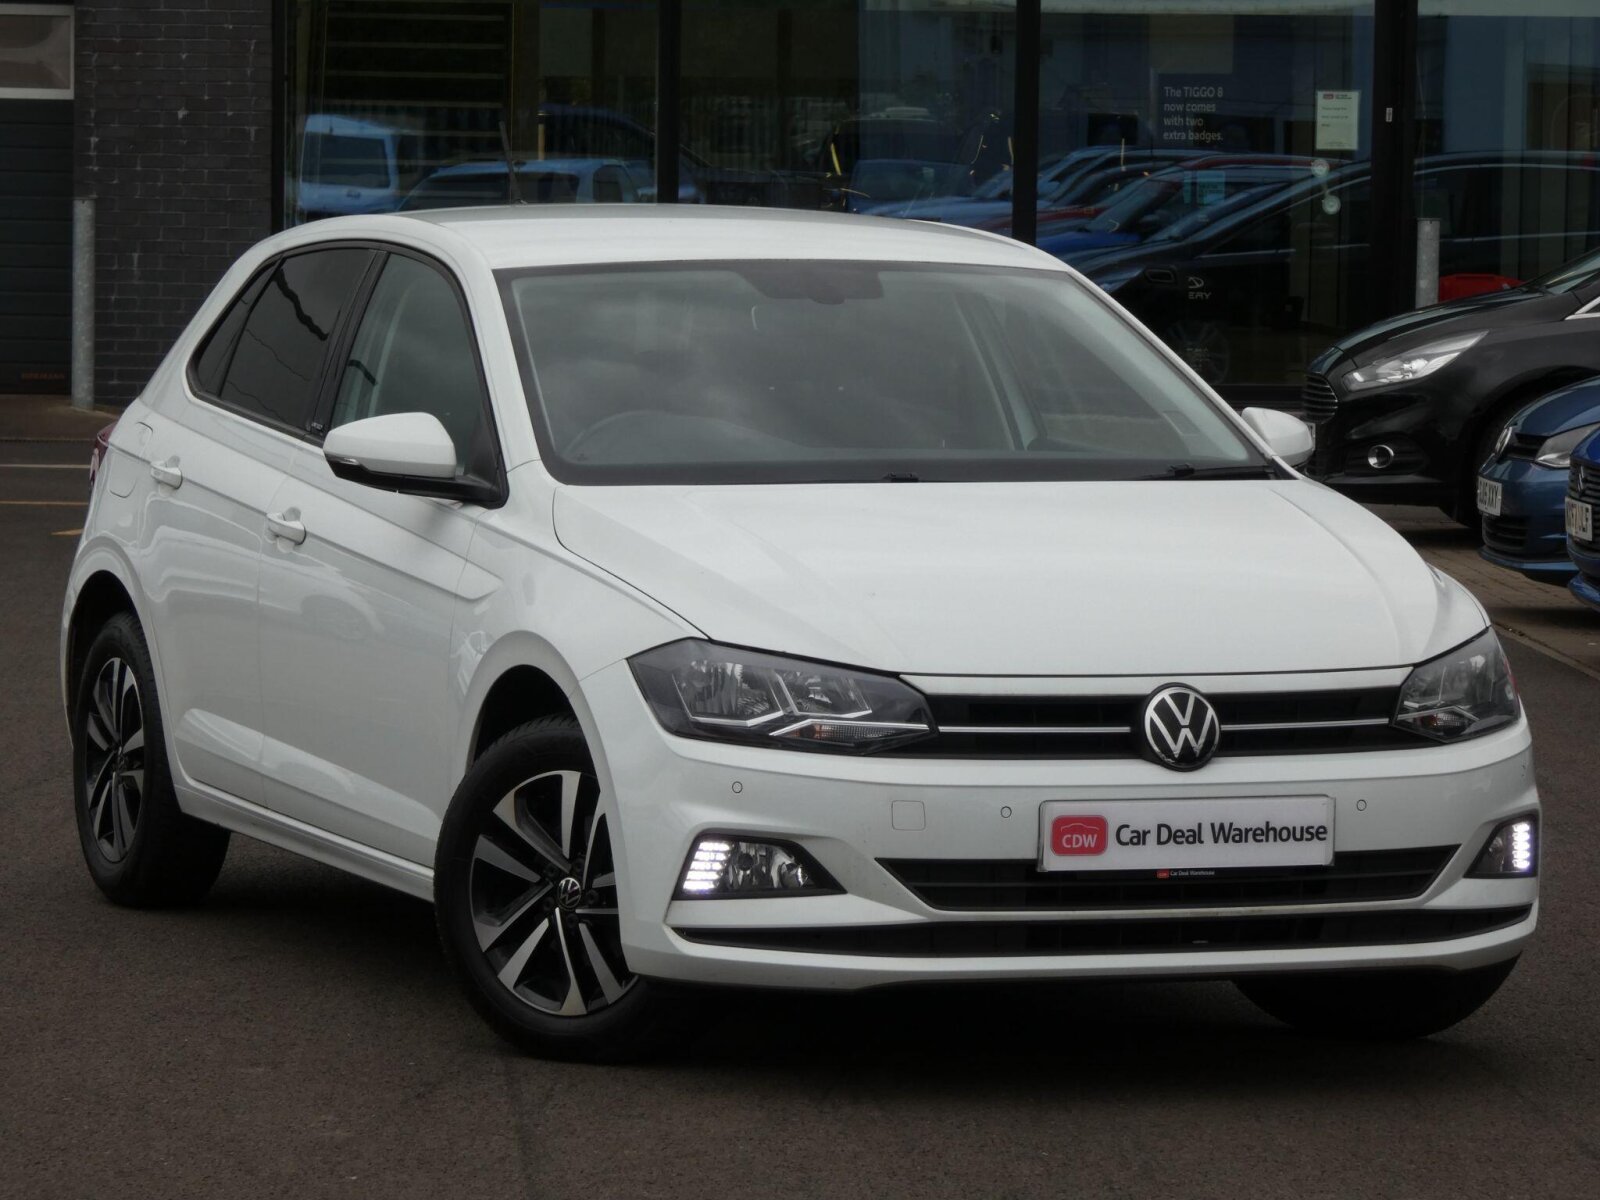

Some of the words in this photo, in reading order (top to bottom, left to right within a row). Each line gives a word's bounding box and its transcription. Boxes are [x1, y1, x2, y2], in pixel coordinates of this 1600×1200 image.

[1163, 86, 1181, 97] The
[1184, 86, 1215, 97] TIGGO
[1217, 86, 1223, 97] 8
[1164, 103, 1184, 112] now
[1186, 103, 1216, 112] comes
[1163, 114, 1183, 126] with
[1186, 116, 1204, 126] two
[1163, 130, 1186, 140] extra
[1188, 129, 1223, 143] badges.
[1115, 824, 1151, 846] Car
[1156, 823, 1204, 845] Deal
[1211, 821, 1328, 844] Warehouse
[1062, 833, 1097, 849] CDW
